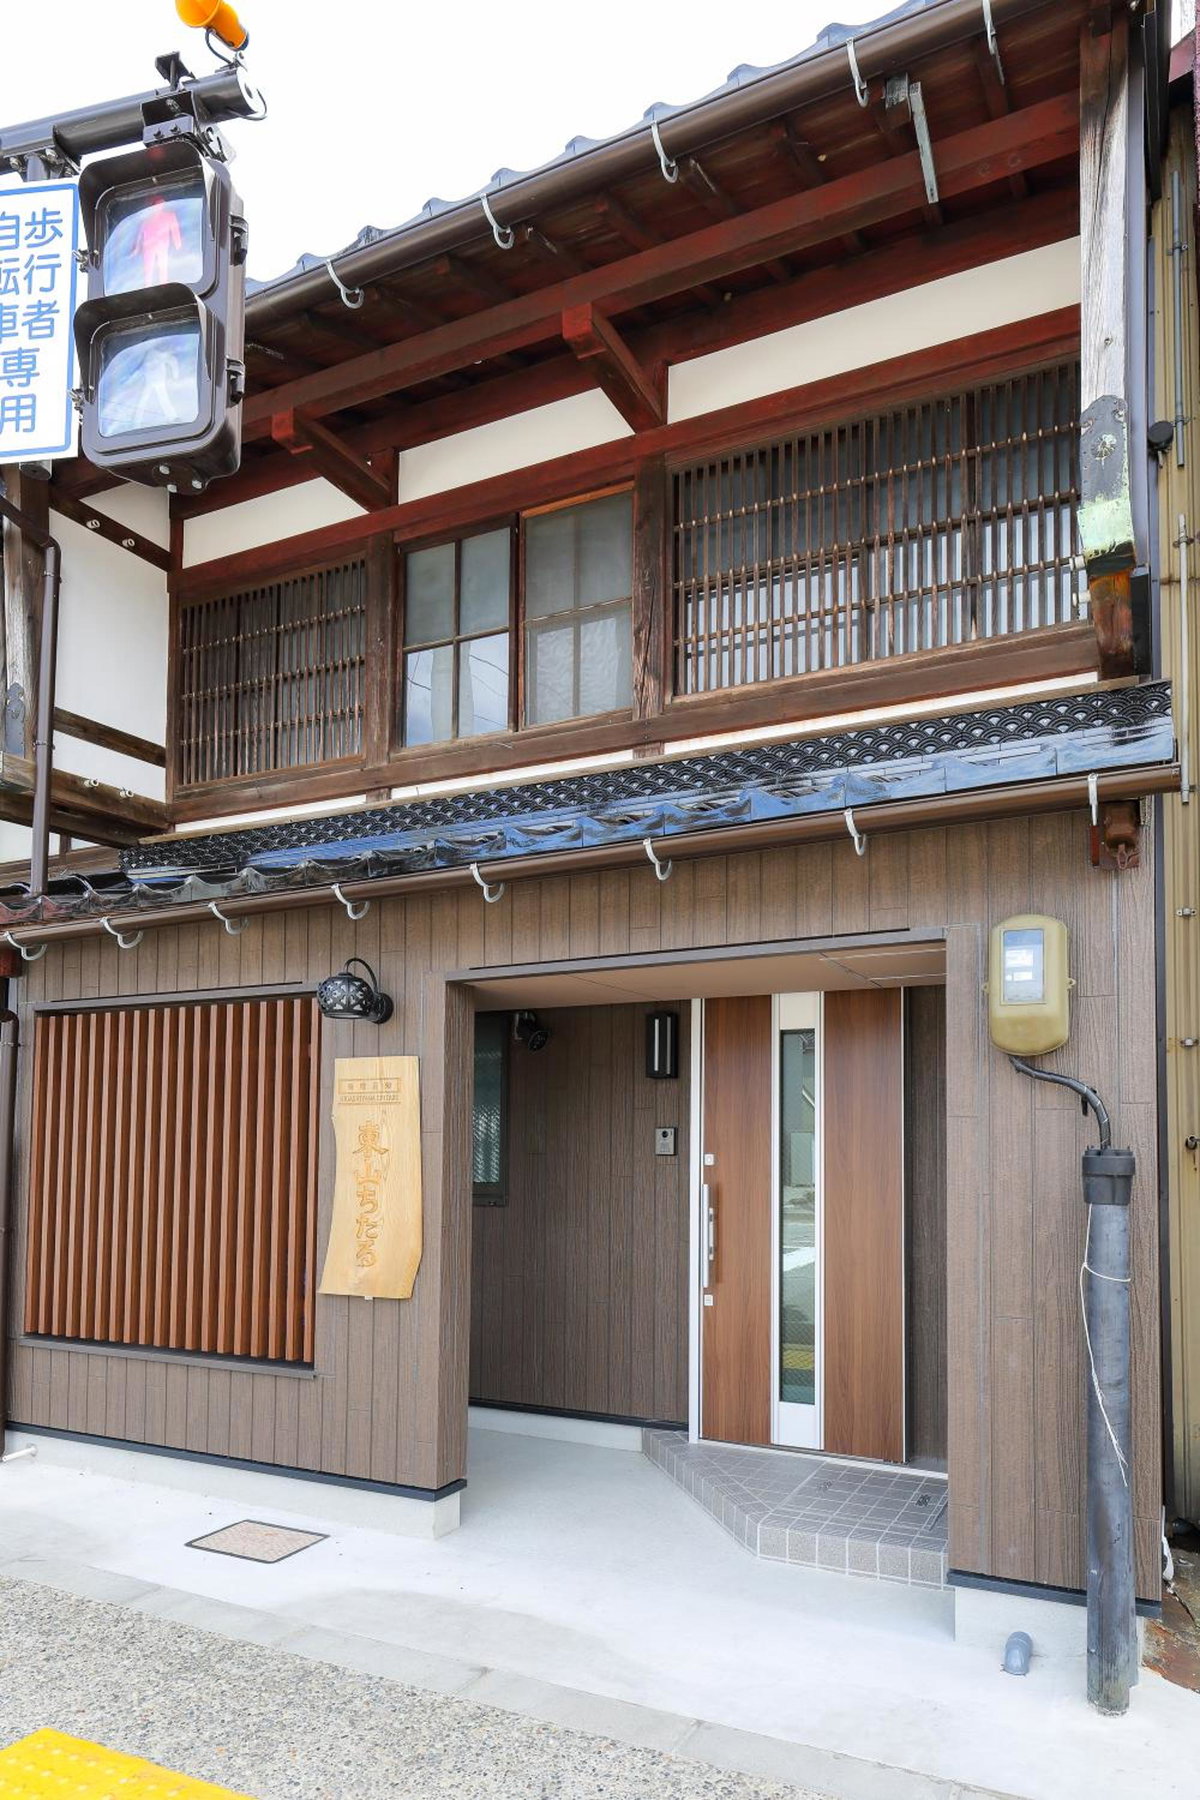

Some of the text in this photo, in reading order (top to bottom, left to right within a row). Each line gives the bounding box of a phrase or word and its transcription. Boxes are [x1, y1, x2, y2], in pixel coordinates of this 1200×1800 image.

[21, 207, 63, 340] 歩行者
[0, 347, 40, 433] 専用
